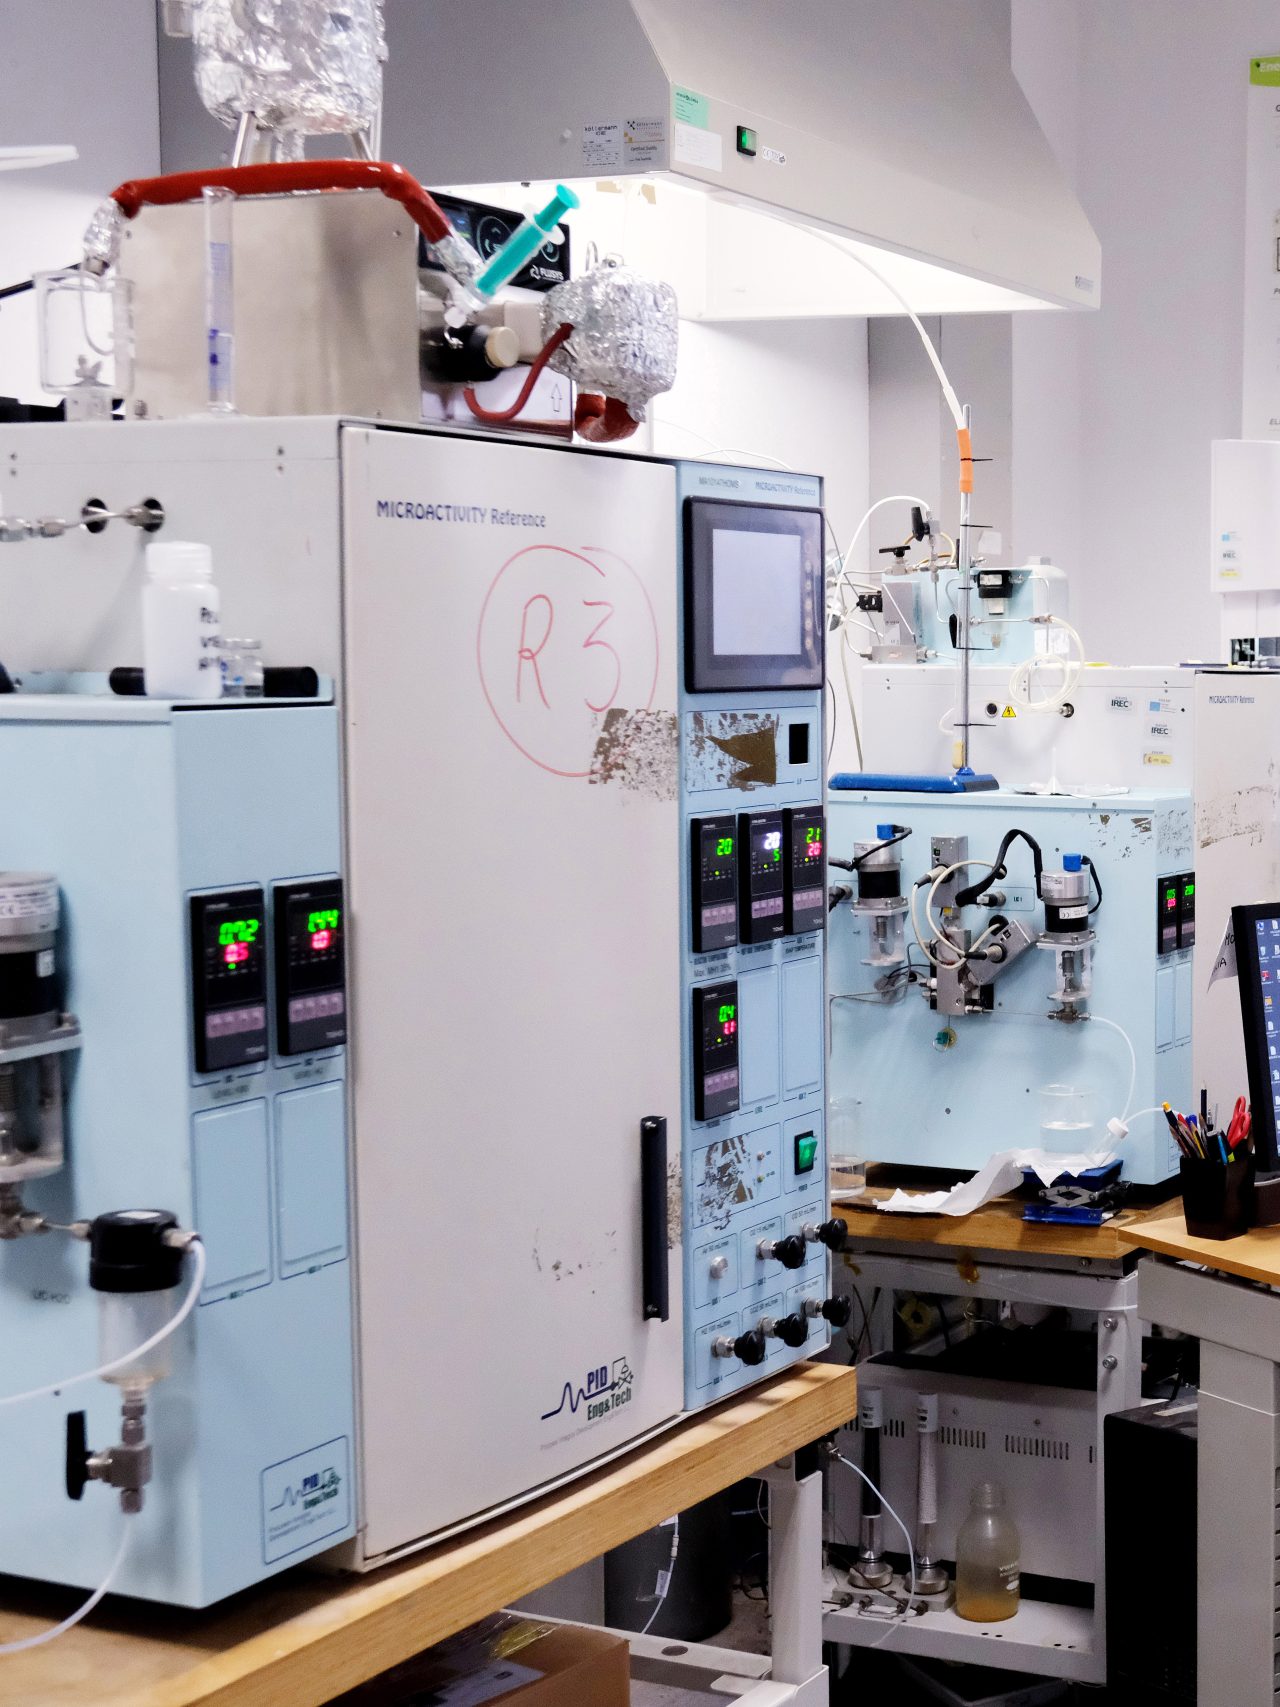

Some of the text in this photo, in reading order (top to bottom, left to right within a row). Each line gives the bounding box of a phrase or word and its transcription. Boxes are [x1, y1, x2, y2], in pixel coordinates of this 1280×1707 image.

[377, 500, 547, 528] MICROACTIVITY Reference
[1111, 699, 1129, 708] IREC
[1151, 727, 1169, 735] IREC
[806, 827, 821, 844] 21
[716, 837, 733, 856] 20
[808, 842, 822, 857] 20
[587, 1365, 608, 1393] PID
[587, 1387, 632, 1421] Eng&Tech
